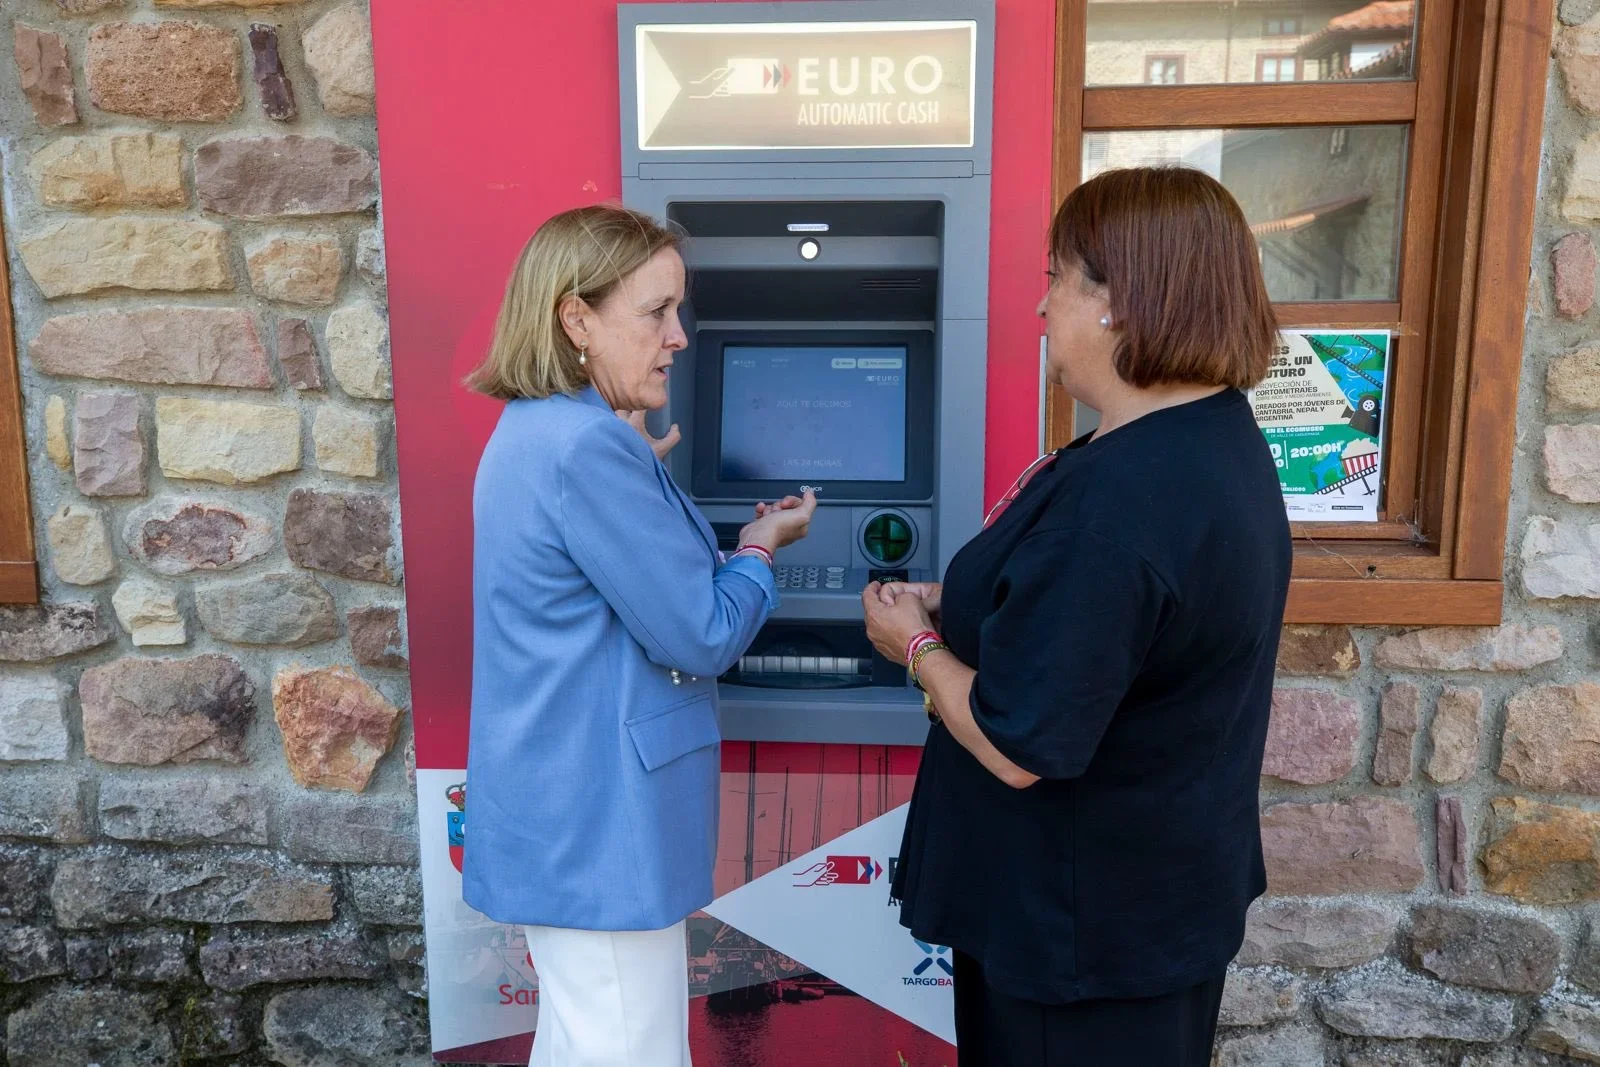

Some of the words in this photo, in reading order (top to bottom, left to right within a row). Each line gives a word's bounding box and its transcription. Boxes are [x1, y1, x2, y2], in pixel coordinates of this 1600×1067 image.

[798, 55, 943, 96] EURO
[798, 102, 892, 126] AUTOMATIC
[898, 101, 939, 124] CASH
[1295, 356, 1312, 365] UN
[1266, 368, 1306, 378] UTURO
[1256, 387, 1318, 396] CORTOMETRAJES
[1256, 402, 1287, 410] CREADOS
[1286, 425, 1324, 433] ECOMUSEO
[1290, 443, 1341, 458] 20:00H
[901, 977, 953, 986] TARGOBA
